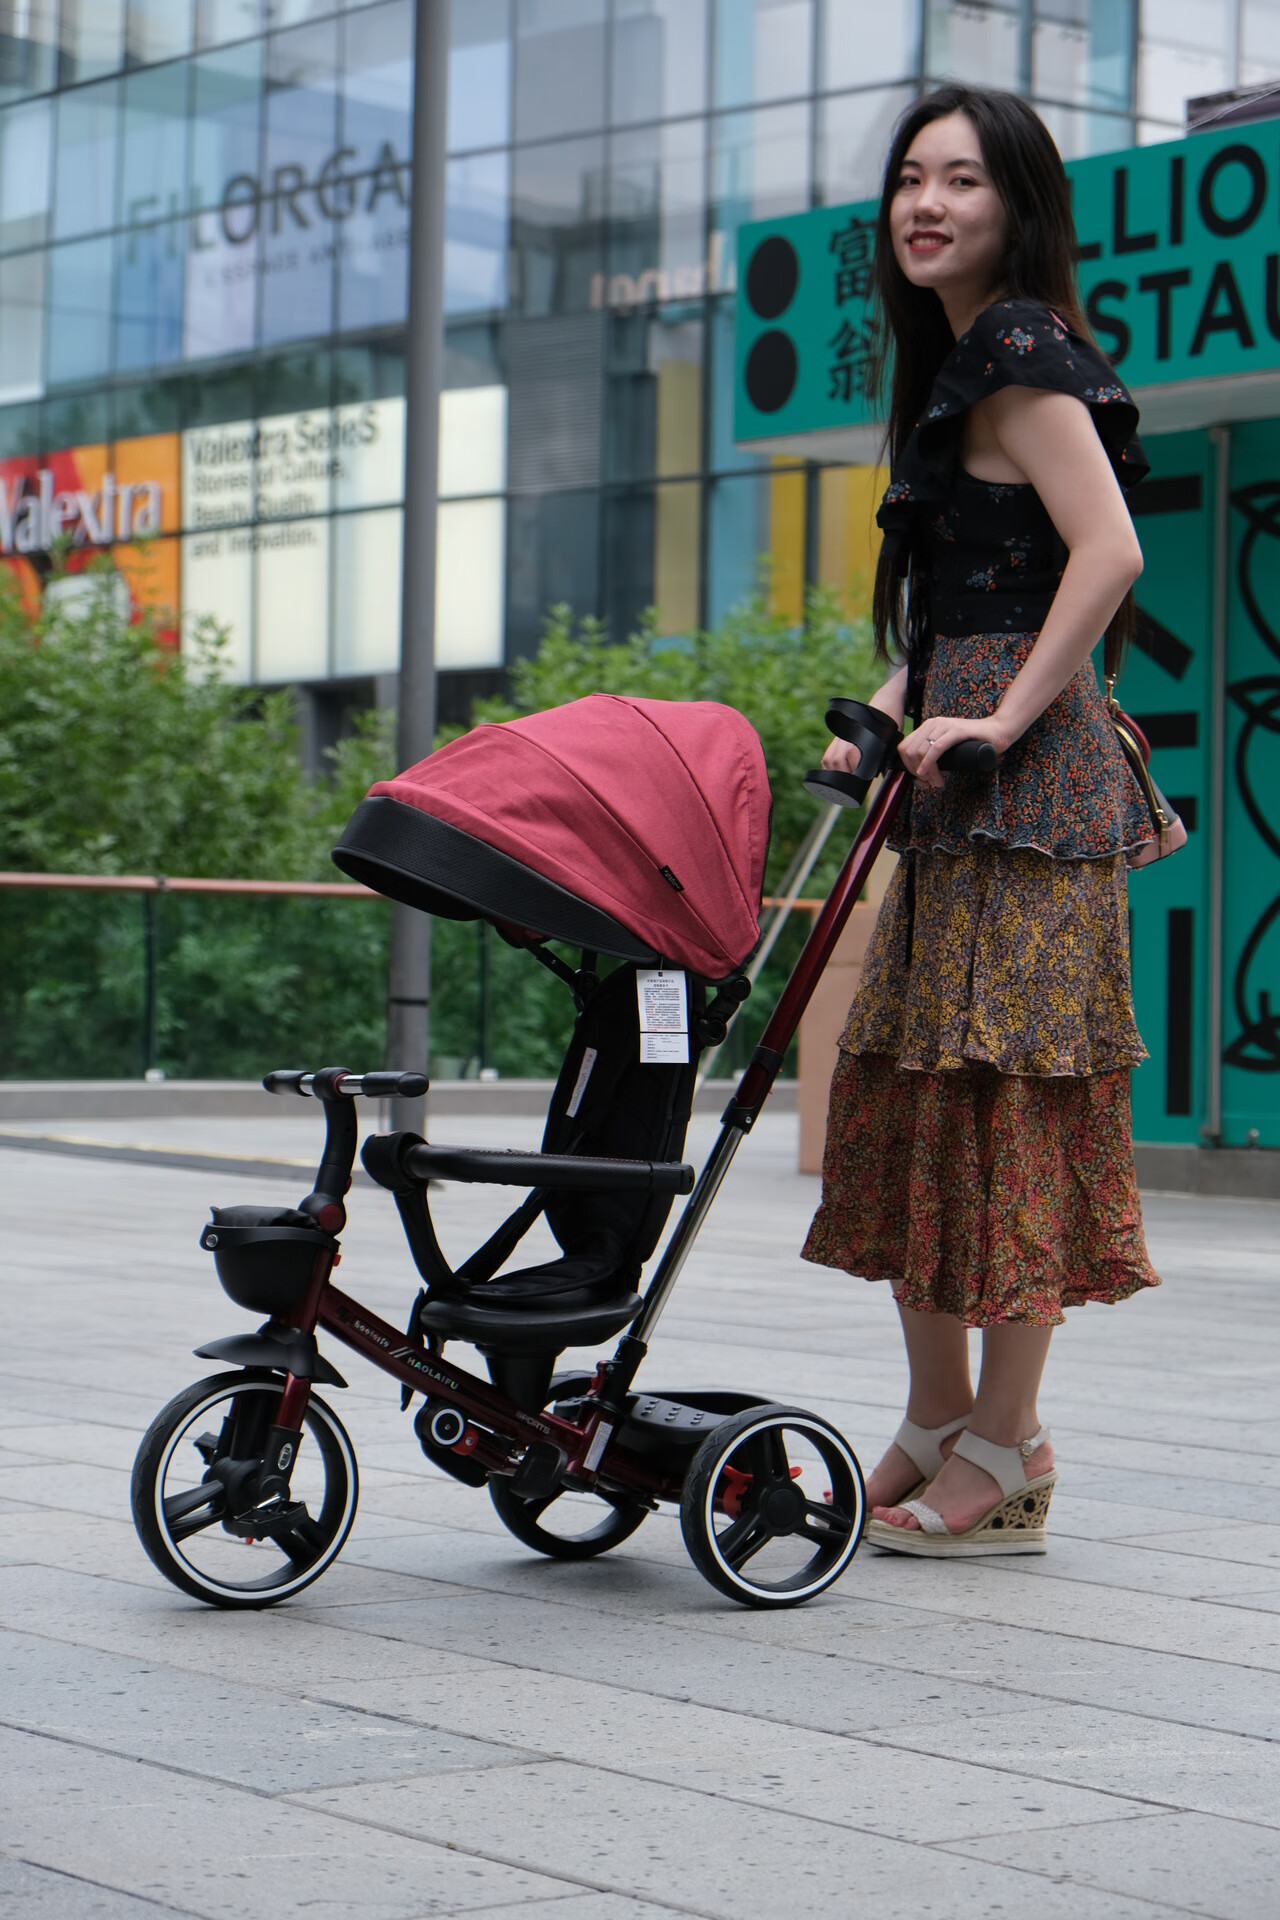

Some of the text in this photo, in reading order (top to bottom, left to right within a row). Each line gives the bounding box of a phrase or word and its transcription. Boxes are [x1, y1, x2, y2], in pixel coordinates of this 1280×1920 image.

[1087, 252, 1280, 369] STA
[0, 468, 162, 553] Valextra
[406, 1356, 460, 1390] HAOLAIFU
[515, 1411, 551, 1435] SPORTS
